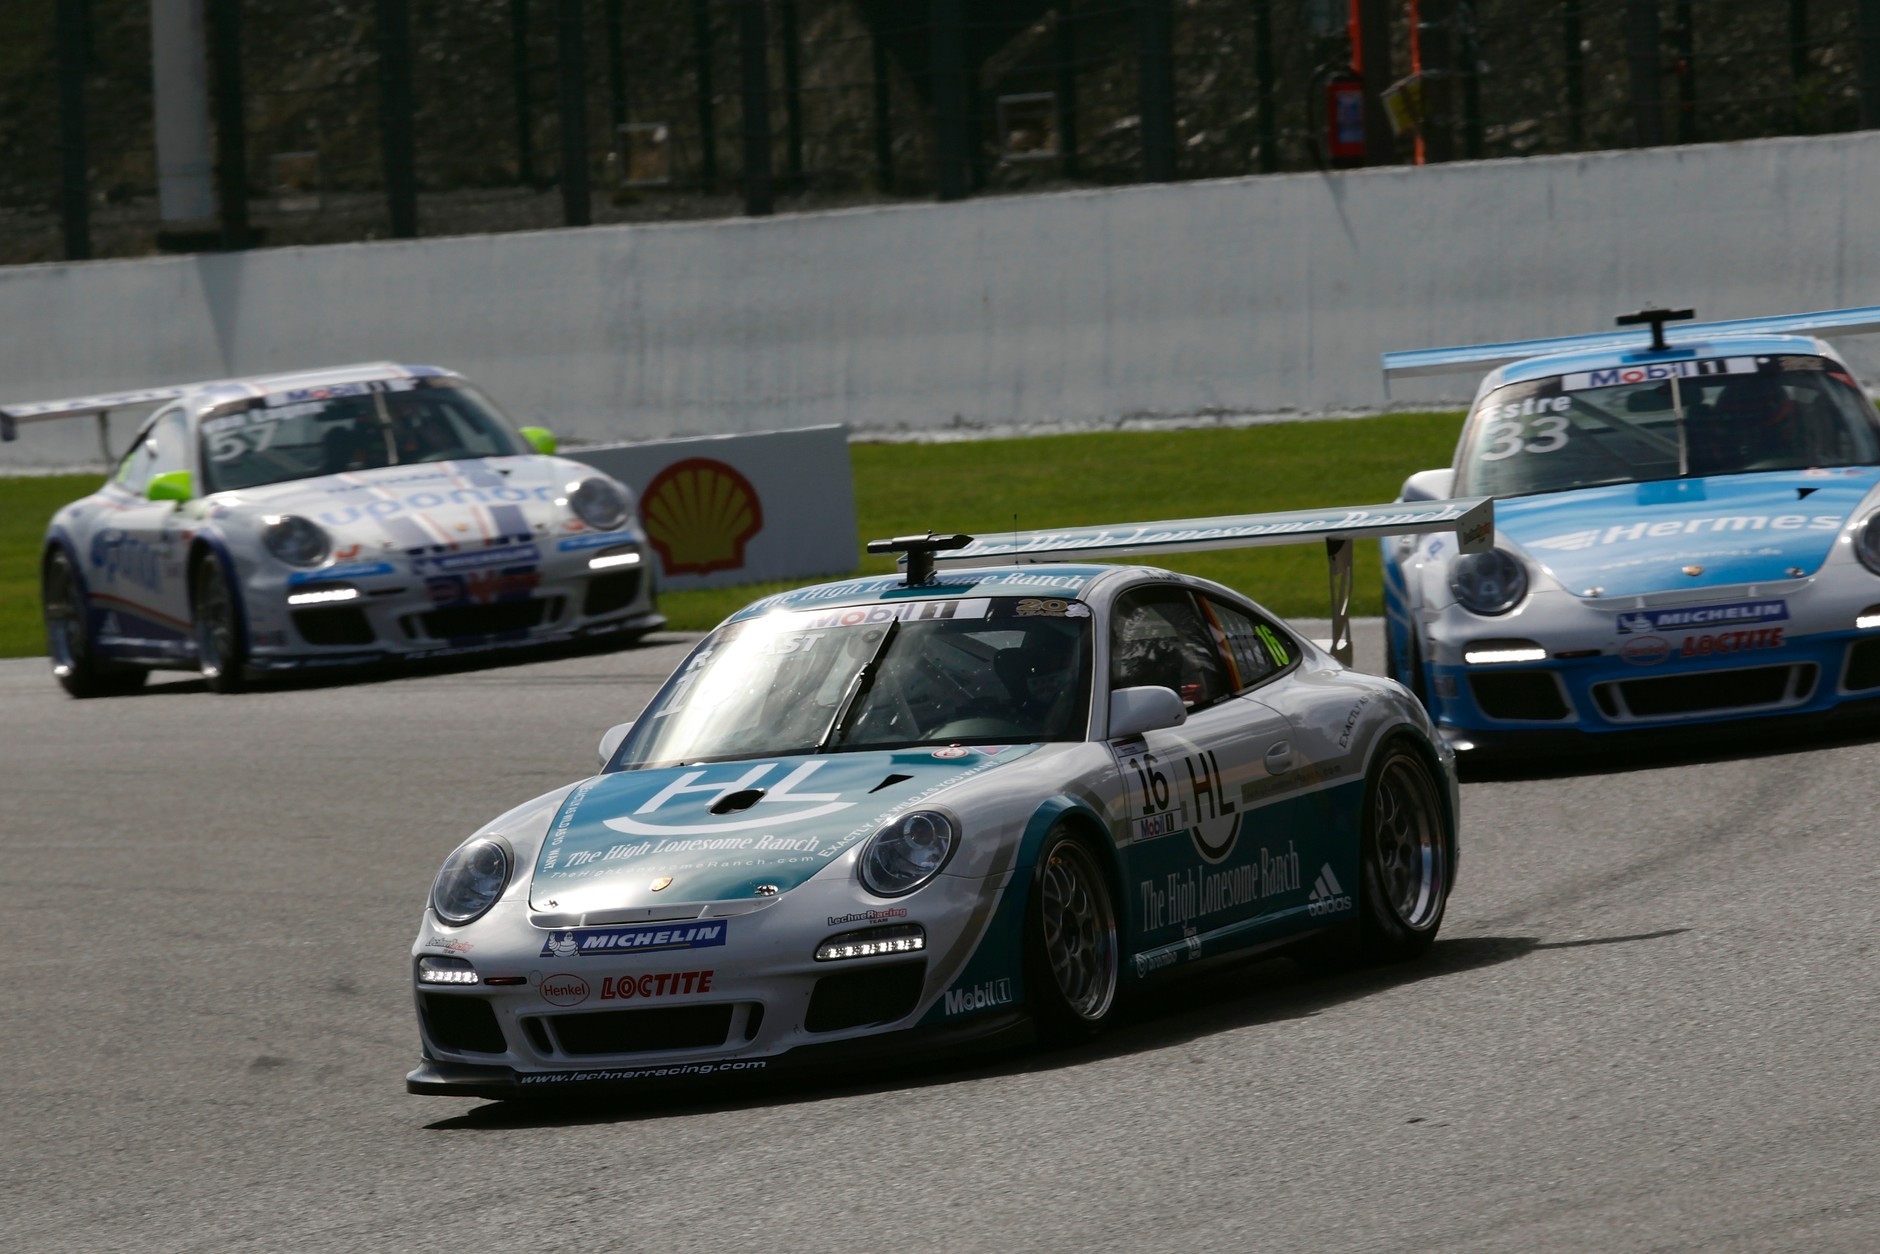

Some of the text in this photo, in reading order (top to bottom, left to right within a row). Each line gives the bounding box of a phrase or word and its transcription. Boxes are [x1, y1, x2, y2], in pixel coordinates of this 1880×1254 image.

[1589, 362, 1687, 387] Mobil
[210, 421, 279, 462] 57
[1480, 416, 1570, 462] 33
[318, 486, 552, 526] uponor
[1331, 504, 1461, 529] Ranch
[1602, 514, 1843, 545] Hermes
[799, 583, 861, 600] High
[997, 572, 1085, 589] Ranch
[806, 603, 917, 630] Mobil
[1016, 599, 1067, 612] 20
[1656, 603, 1782, 626] MICHELIN
[1255, 624, 1290, 667] 16
[1679, 626, 1785, 657] LOCTITE
[1338, 705, 1362, 749] EXACTLY
[632, 760, 841, 815] HL
[1128, 753, 1170, 816] 16
[1185, 749, 1235, 823] HL
[817, 821, 874, 858] EXACTLY
[873, 812, 893, 825] AS
[890, 795, 922, 816] WILD
[920, 785, 938, 797] AS
[936, 773, 965, 789] YOU
[1140, 814, 1166, 839] Mobil
[564, 834, 820, 869] The High Lonesome Ranch
[1140, 840, 1301, 932] The High Lonesome Ranch
[827, 907, 907, 926] LechneRacing
[1307, 896, 1352, 917] adidas
[582, 925, 722, 949] MICHELIN
[544, 984, 586, 997] Henkel
[600, 970, 714, 1000] LOCTITE
[945, 980, 996, 1016] Mobil
[520, 1060, 767, 1085] www.lechnerracing.com
